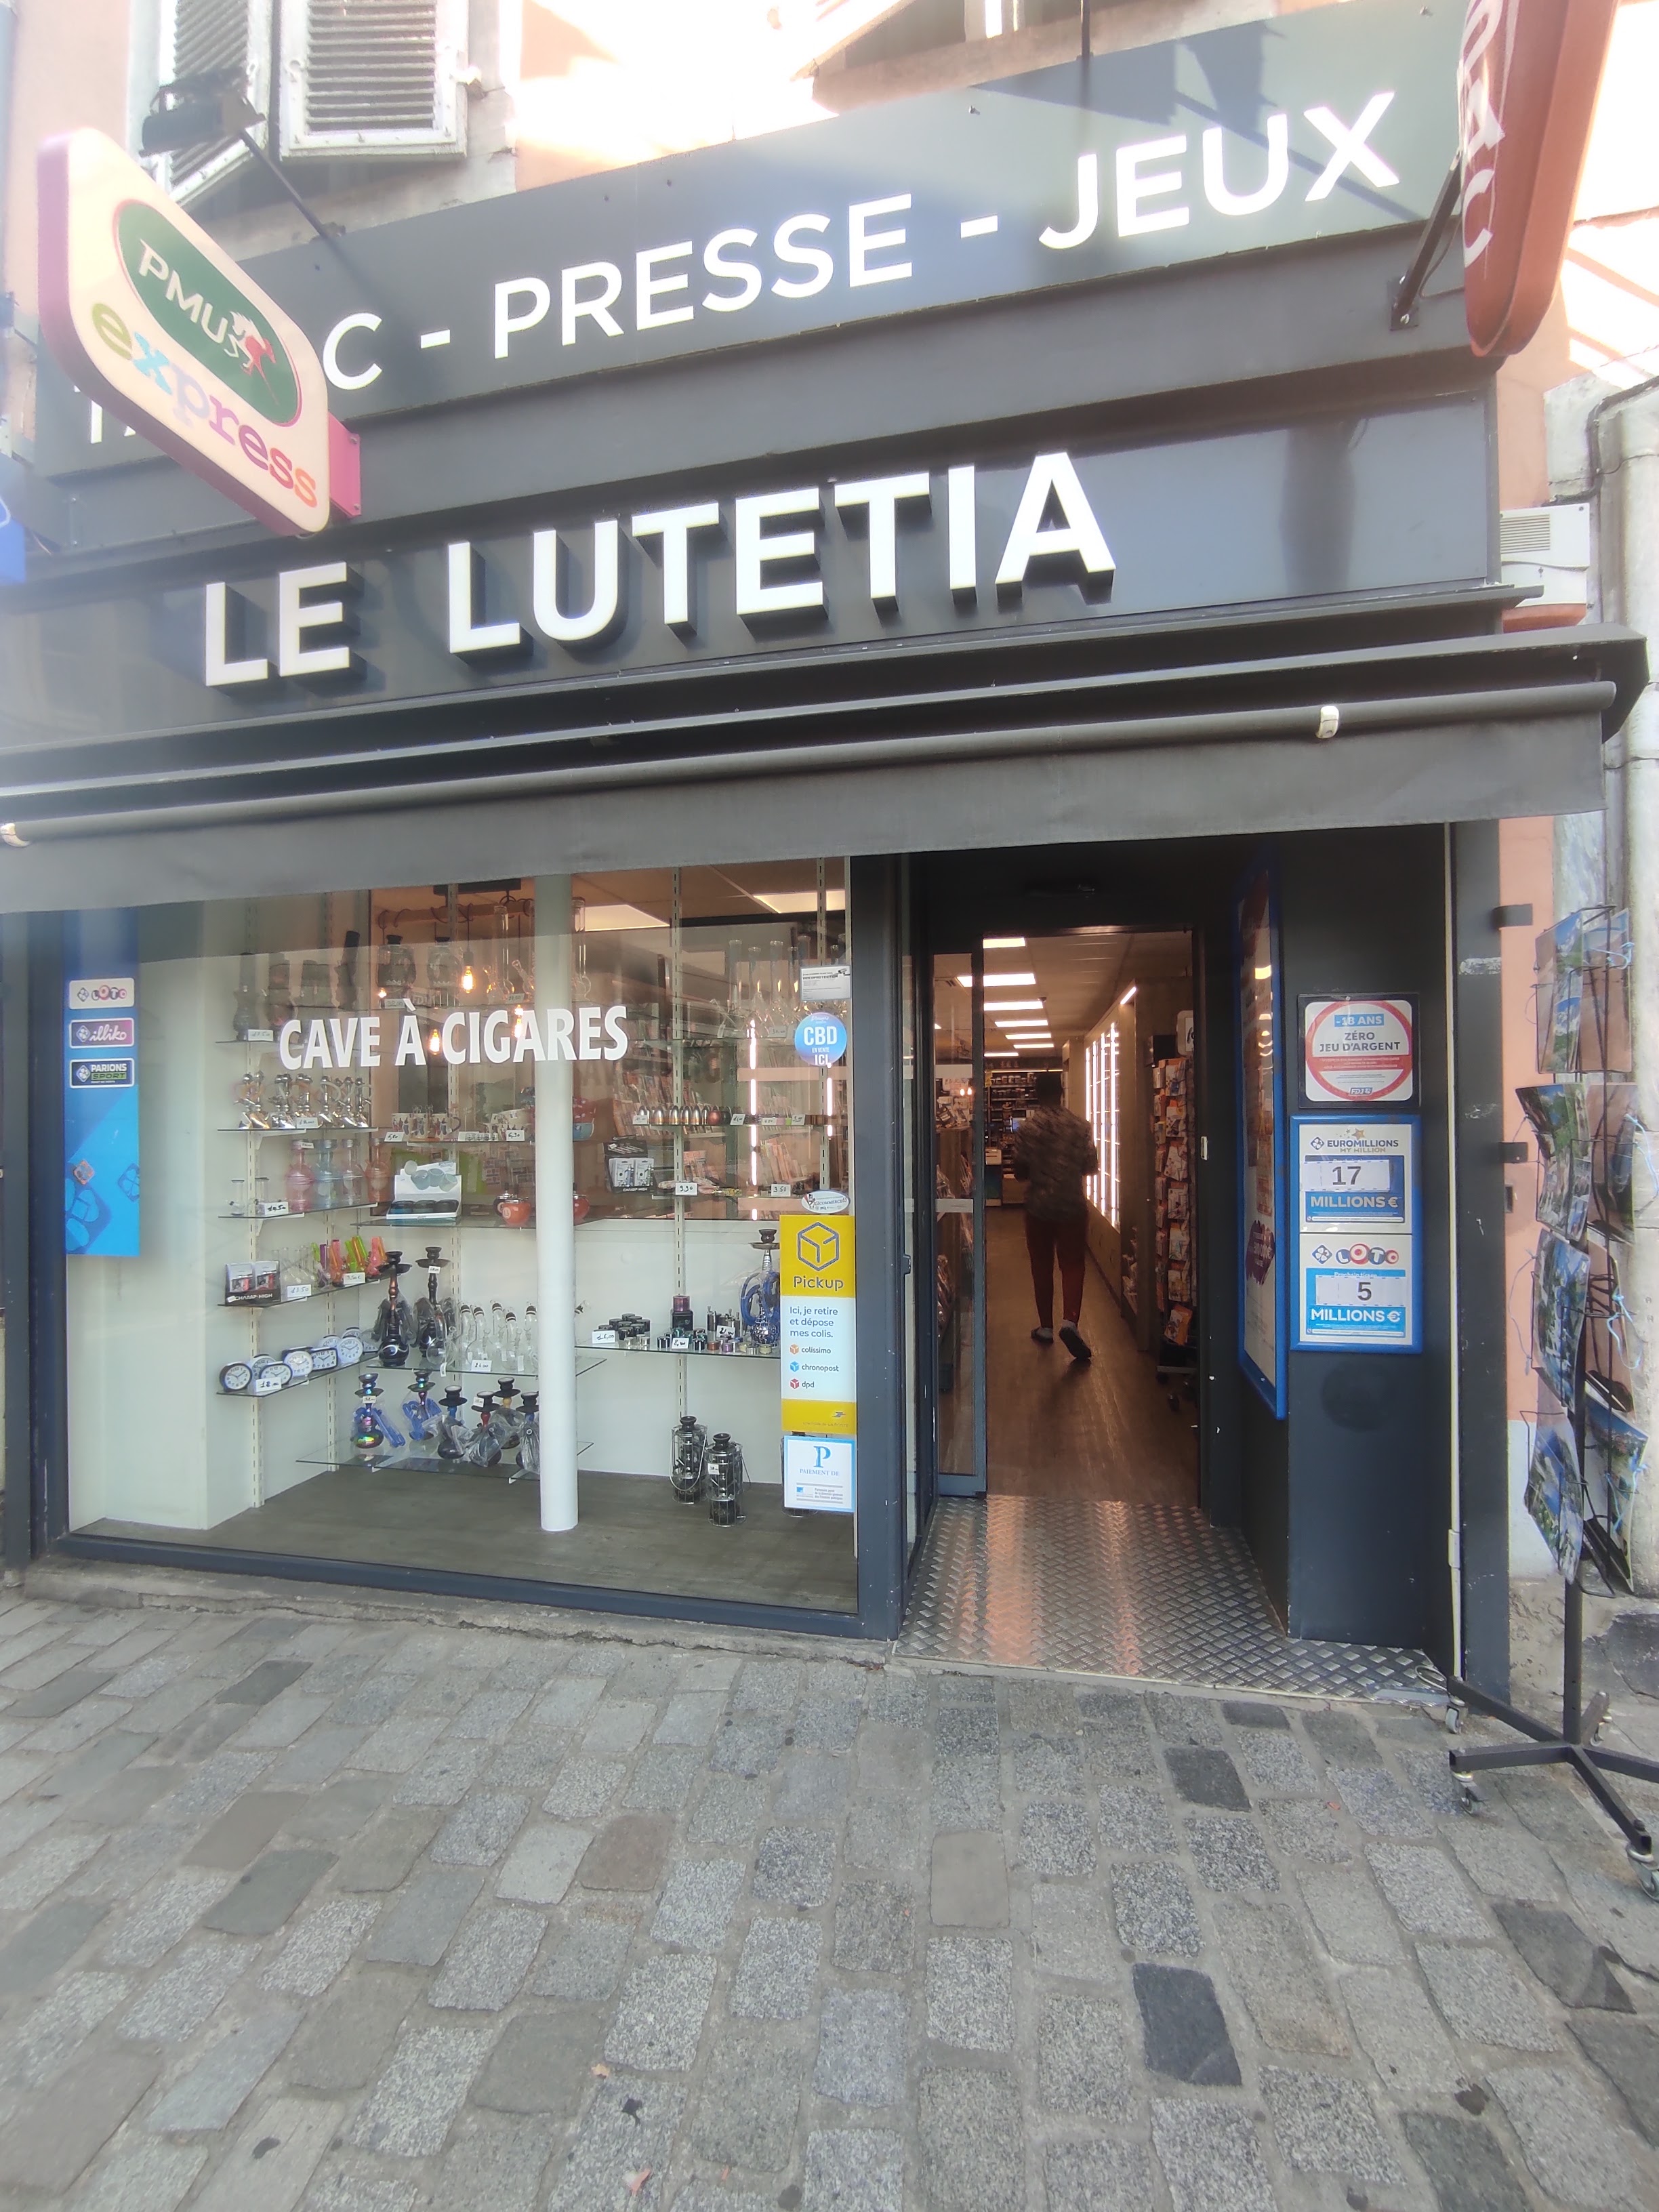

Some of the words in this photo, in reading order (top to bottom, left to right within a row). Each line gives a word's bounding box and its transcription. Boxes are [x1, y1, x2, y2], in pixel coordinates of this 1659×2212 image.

[494, 192, 913, 359] PRESSE
[1039, 91, 1400, 249] JEUX
[138, 239, 228, 344] PMU
[92, 303, 318, 508] express
[205, 561, 352, 687] LE
[449, 451, 1117, 654] LUTETIA
[91, 985, 127, 1001] LOTO
[1357, 1015, 1382, 1025] ANS
[89, 1024, 127, 1042] illiko
[280, 1017, 382, 1070] CAVE
[395, 998, 426, 1066] À
[442, 1006, 628, 1065] CIGARES
[804, 1026, 838, 1046] CBD
[1344, 1030, 1375, 1041] ZÉRO
[1319, 1044, 1340, 1052] JEU
[1342, 1042, 1401, 1052] D'ARGENT
[815, 1054, 829, 1065] ICI
[91, 1063, 127, 1072] PARIONS
[1327, 1139, 1399, 1148] EUROMILLIONS
[1332, 1166, 1361, 1185] 17
[1311, 1196, 1385, 1208] MILLIONS
[1388, 1197, 1400, 1208] €
[1336, 1243, 1399, 1265] LOTO
[793, 1276, 844, 1291] Pickup
[1357, 1282, 1372, 1300] 5
[790, 1307, 802, 1316] Ici,
[803, 1307, 812, 1316] je
[814, 1307, 838, 1315] retire
[1311, 1310, 1385, 1322] MILLIONS
[1387, 1311, 1401, 1322] €
[801, 1317, 834, 1328] dépose
[811, 1330, 834, 1338] colis.
[801, 1346, 832, 1354] colissimo
[801, 1364, 839, 1372] chronopost
[802, 1381, 815, 1389] dpd
[813, 1446, 831, 1468] P
